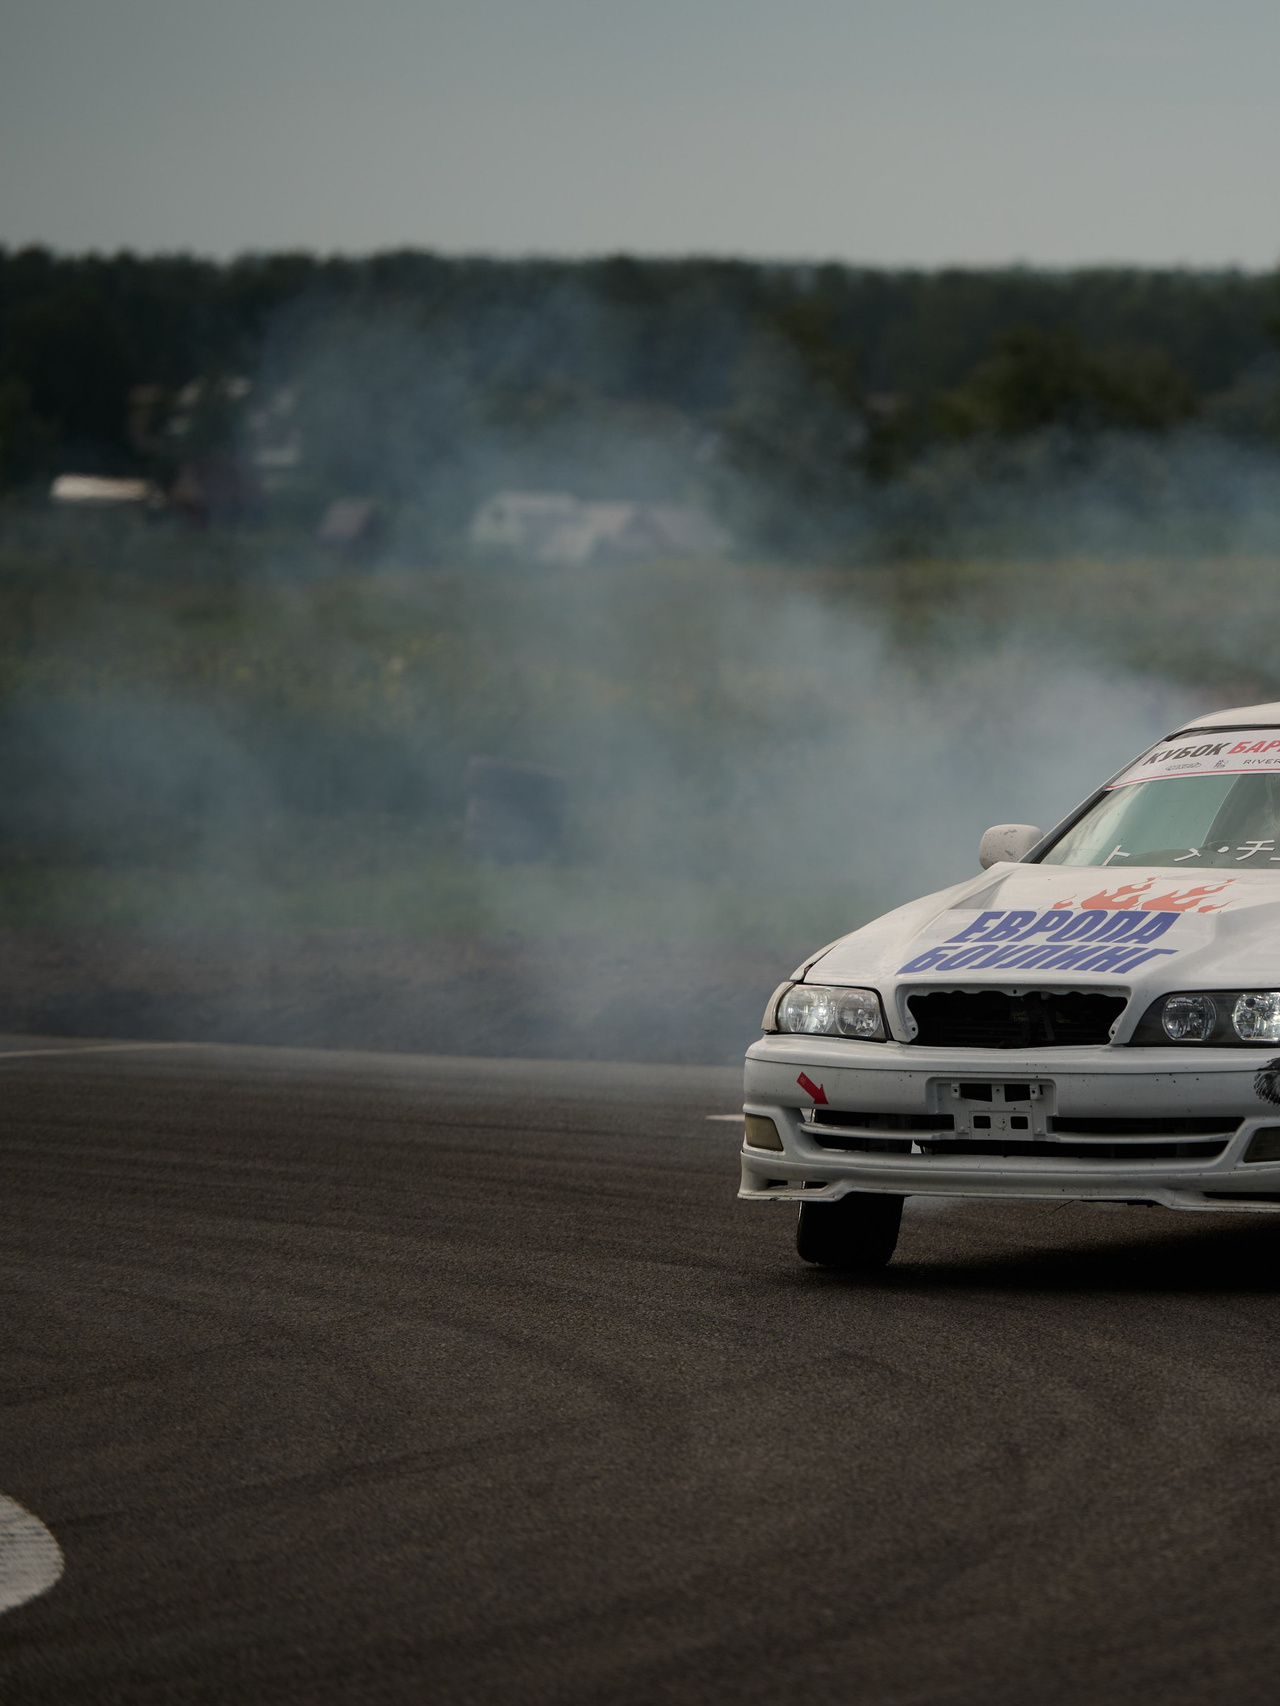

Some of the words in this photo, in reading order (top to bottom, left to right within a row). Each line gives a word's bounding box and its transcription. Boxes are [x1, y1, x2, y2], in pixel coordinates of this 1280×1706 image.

[1144, 741, 1235, 766] КУБОК
[943, 910, 1181, 944] ЕВРОПА
[895, 945, 1179, 975] БОУЛИНГ
